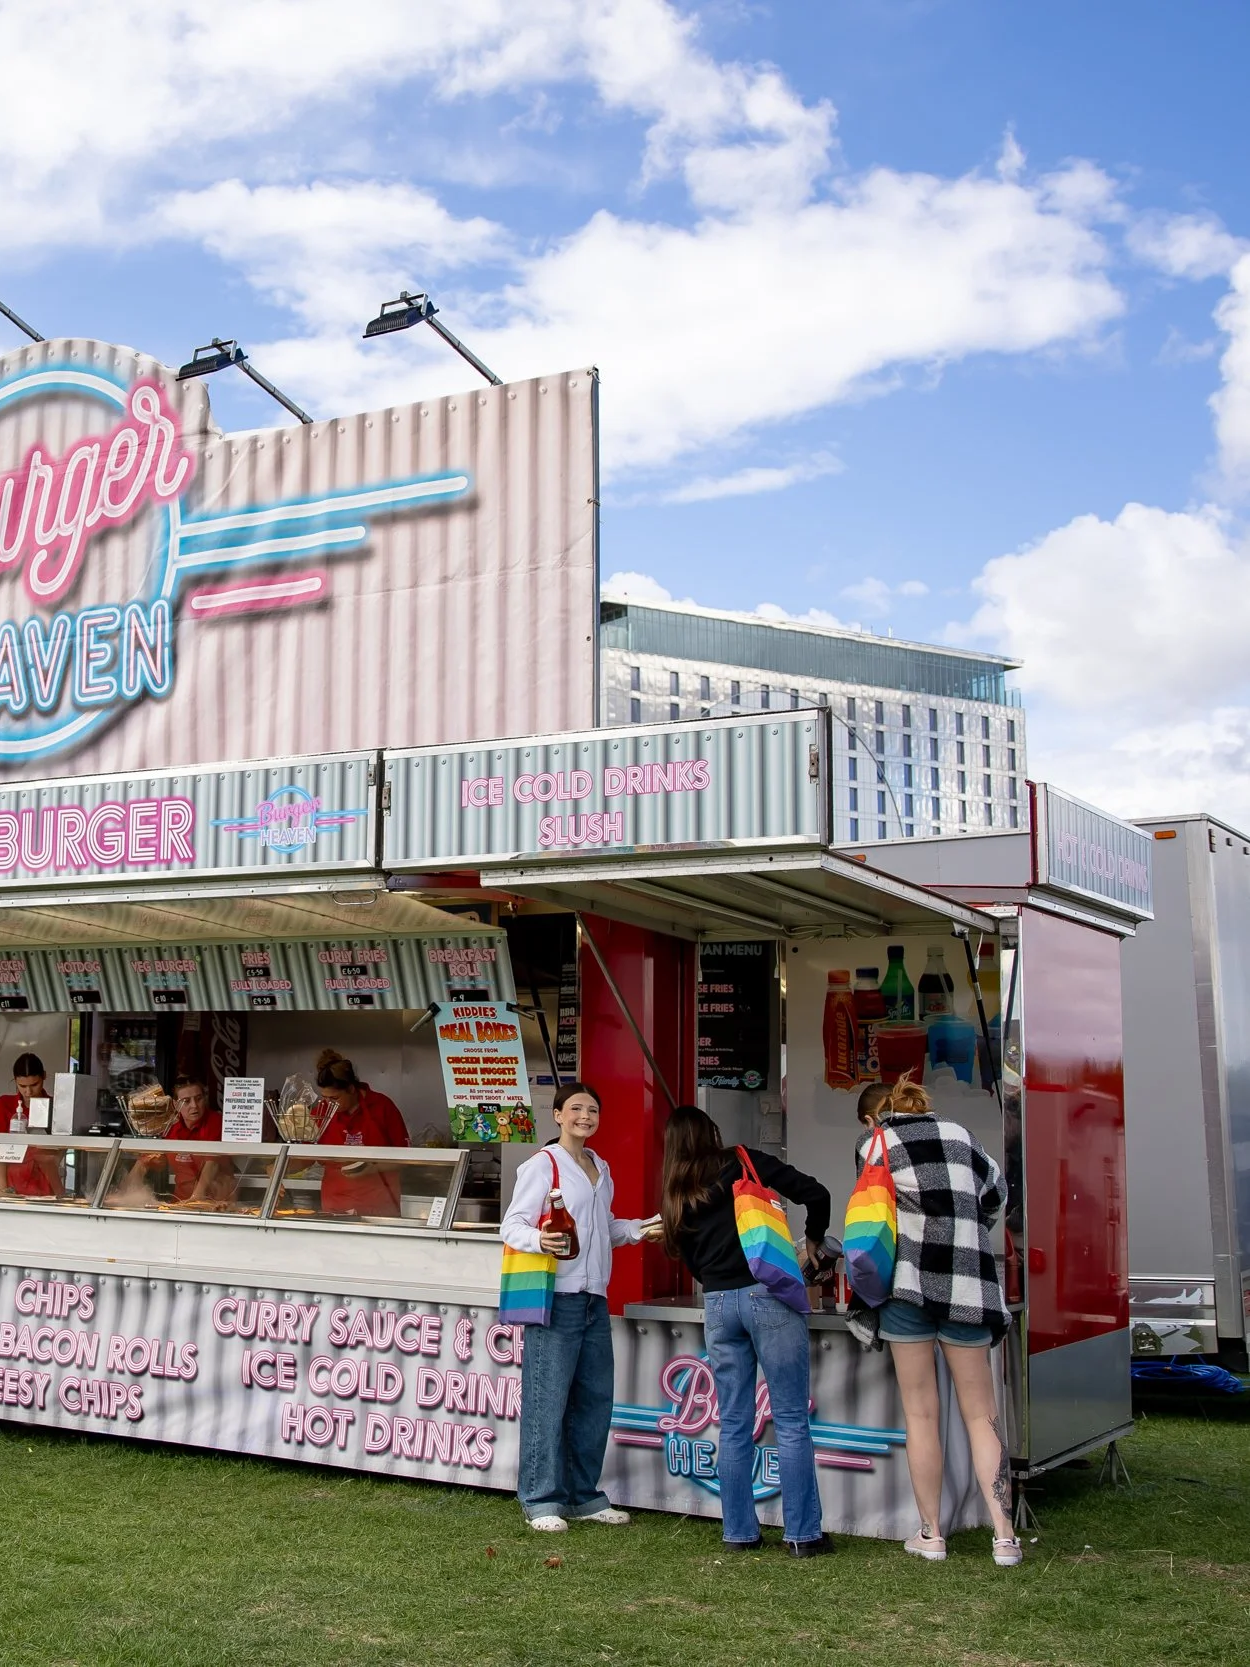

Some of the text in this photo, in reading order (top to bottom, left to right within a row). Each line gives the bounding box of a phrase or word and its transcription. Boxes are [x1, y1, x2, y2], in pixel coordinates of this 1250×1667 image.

[461, 759, 711, 808] ICE COLD DRINKS
[256, 796, 323, 828] Burger
[260, 825, 317, 846] HEAVEN
[538, 811, 624, 847] SLUSH
[1057, 831, 1078, 865] HOT
[1089, 843, 1114, 880] COLD
[1118, 854, 1148, 893] DRINKS
[318, 949, 388, 964] CURLY FRIES
[428, 948, 496, 963] BREAKFAST
[725, 944, 762, 956] MENU
[56, 960, 101, 973] HOTDOG
[131, 959, 197, 973] VEG BURGER
[241, 952, 271, 966] FRIES
[448, 962, 481, 977] ROLL
[230, 979, 292, 991] FULLY LOADED
[325, 977, 391, 990] FULLY LOADED
[710, 984, 734, 993] FRIES
[452, 1006, 497, 1019] KIDDIES
[710, 1003, 734, 1012] FRIES
[439, 1021, 518, 1043] MEAL BOXES
[698, 1038, 712, 1047] ER
[836, 1011, 847, 1071] Lucozade
[446, 1056, 519, 1065] CHICKEN NUGGETS
[452, 1067, 516, 1076] VEGAN NUGGETS
[454, 1077, 518, 1086] SMALL SAUSAGE
[15, 1278, 95, 1321] CHIPS
[212, 1297, 318, 1343] CURRY
[328, 1307, 441, 1355] SAUCE
[454, 1318, 473, 1360] &
[106, 1334, 199, 1381] ROLLS
[242, 1349, 296, 1390] ICE
[308, 1355, 404, 1402] COLD
[58, 1375, 143, 1421] CHIPS
[281, 1402, 496, 1467] HOT DRINKS
